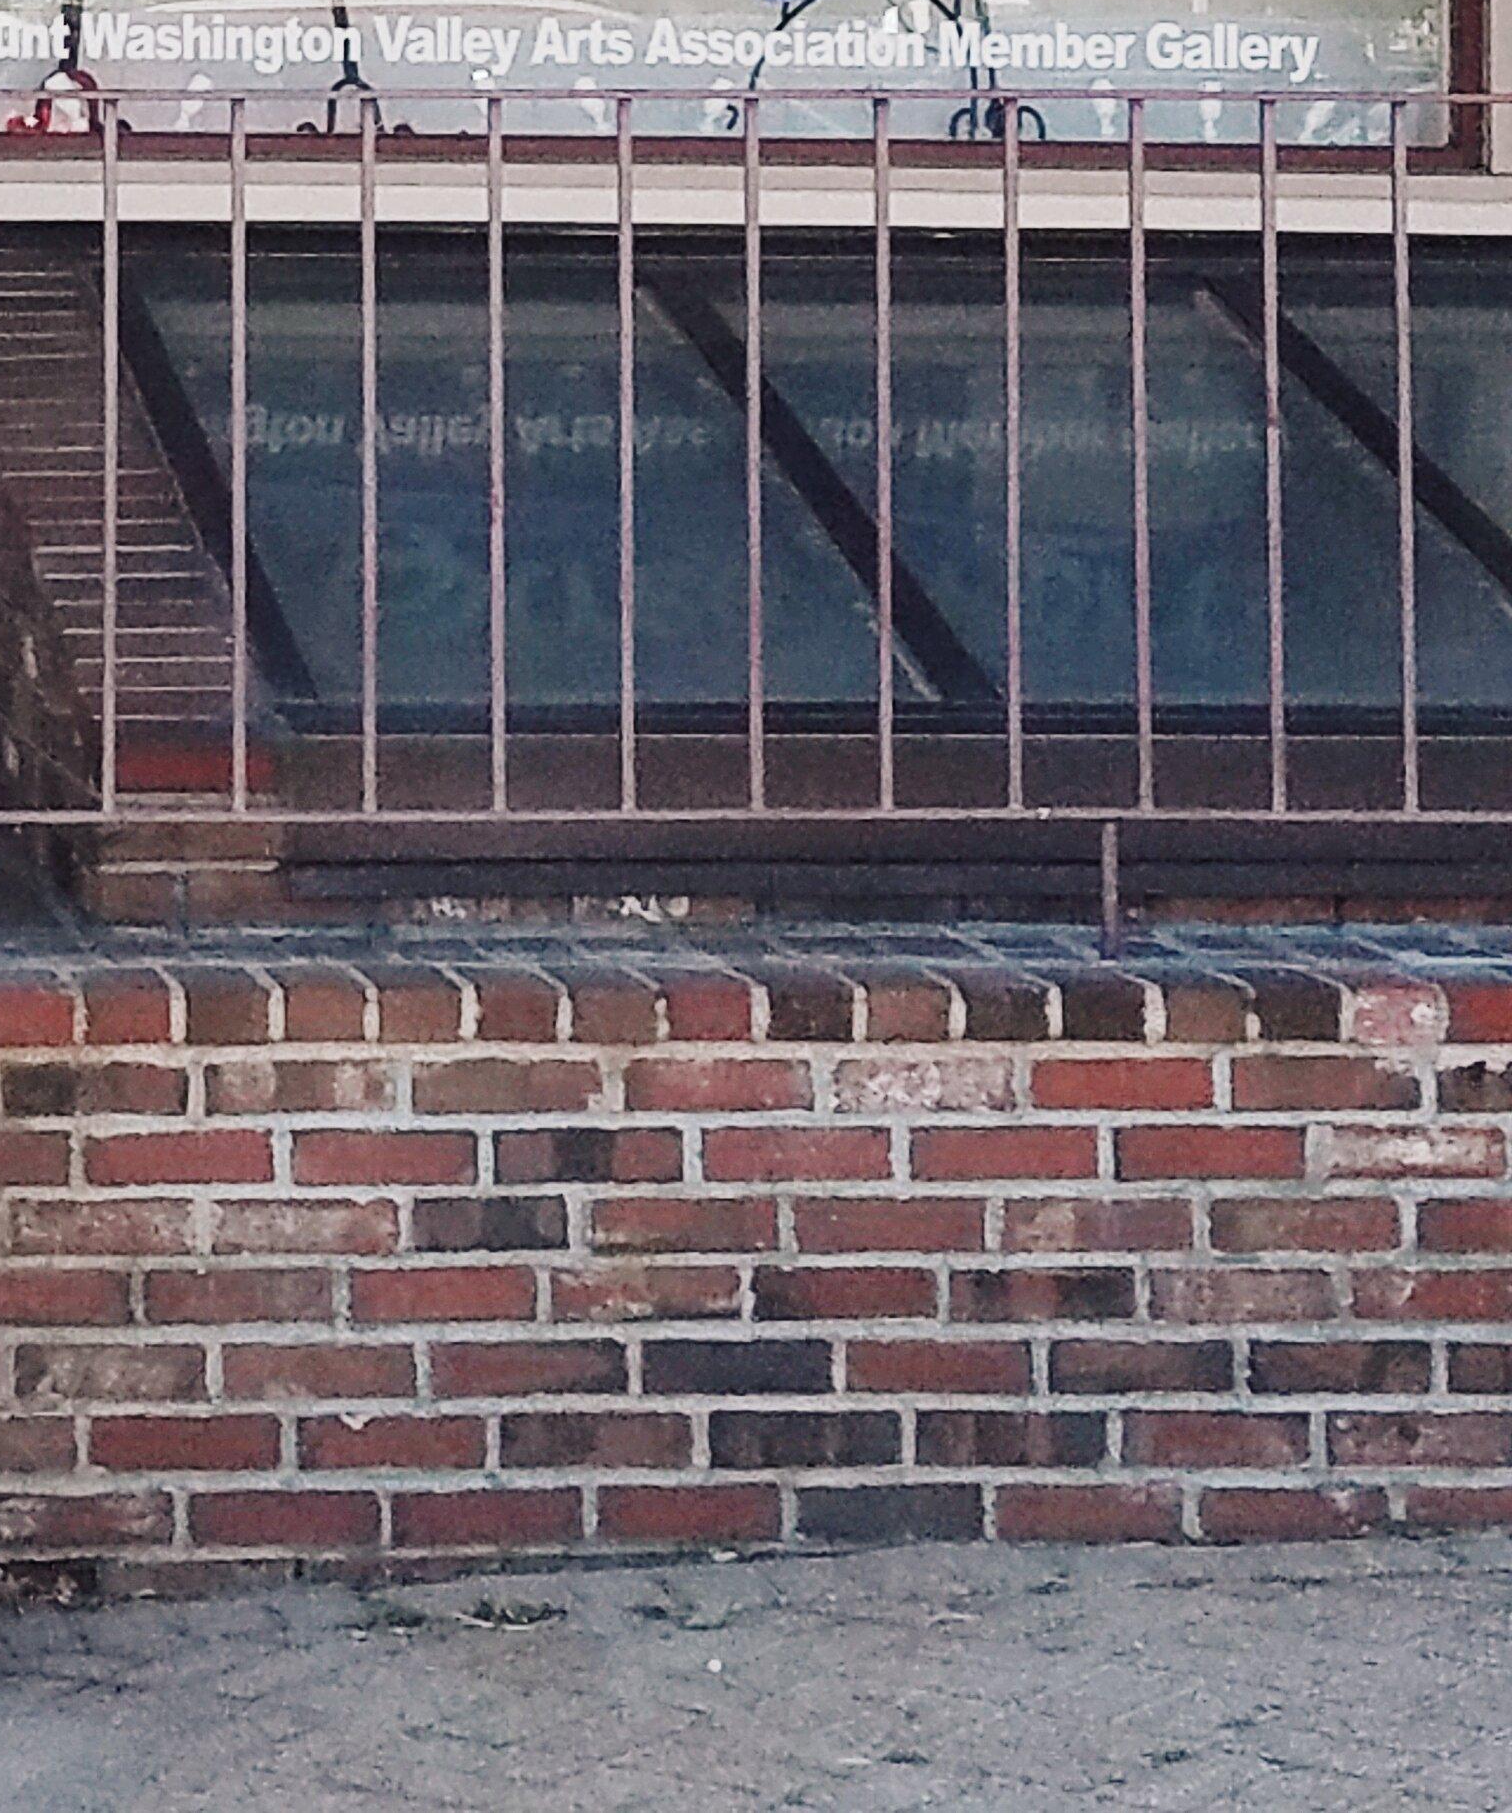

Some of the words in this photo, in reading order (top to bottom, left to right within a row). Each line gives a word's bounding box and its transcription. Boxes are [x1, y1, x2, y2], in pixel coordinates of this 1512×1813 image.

[80, 12, 363, 75] Washington
[373, 15, 522, 77] Valley
[530, 17, 634, 65] Arts
[644, 17, 925, 68] Association
[939, 19, 1137, 69] Member
[1146, 21, 1320, 83] Gallery
